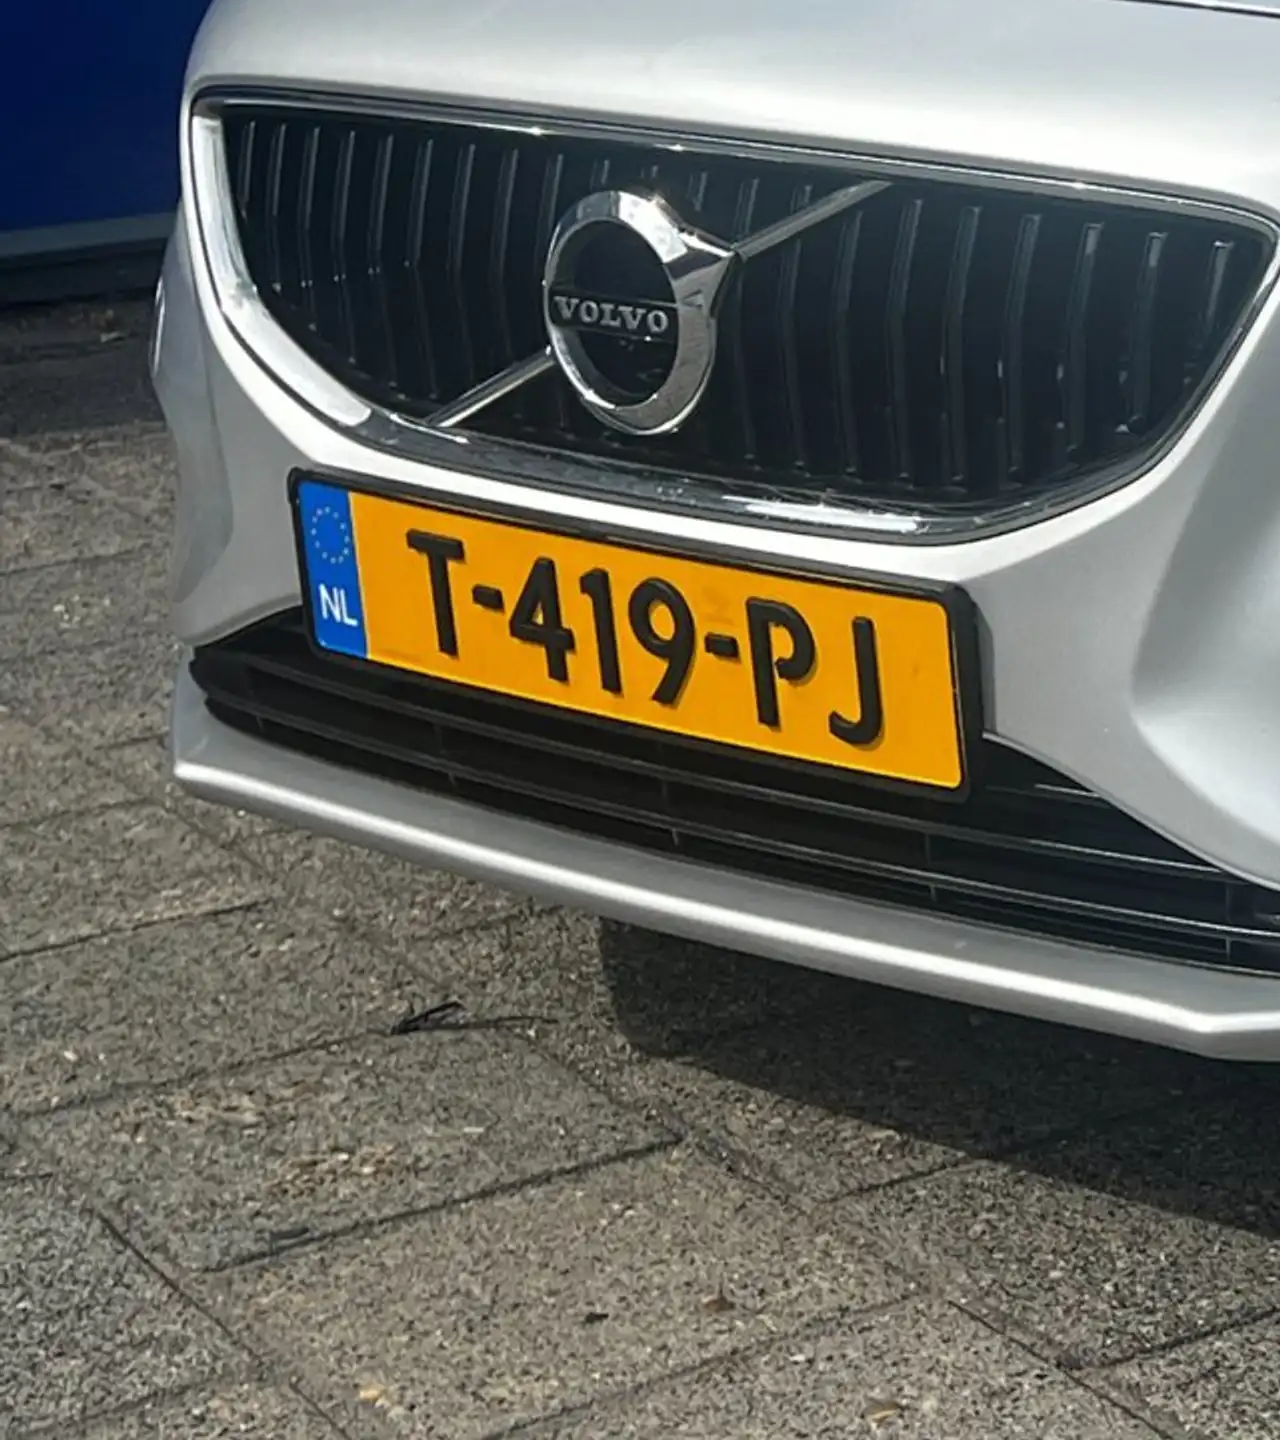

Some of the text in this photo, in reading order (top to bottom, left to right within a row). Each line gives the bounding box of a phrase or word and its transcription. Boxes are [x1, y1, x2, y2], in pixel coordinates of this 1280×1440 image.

[553, 295, 669, 334] VOLVO
[317, 584, 359, 628] NL
[406, 527, 885, 748] T-419-PJ
